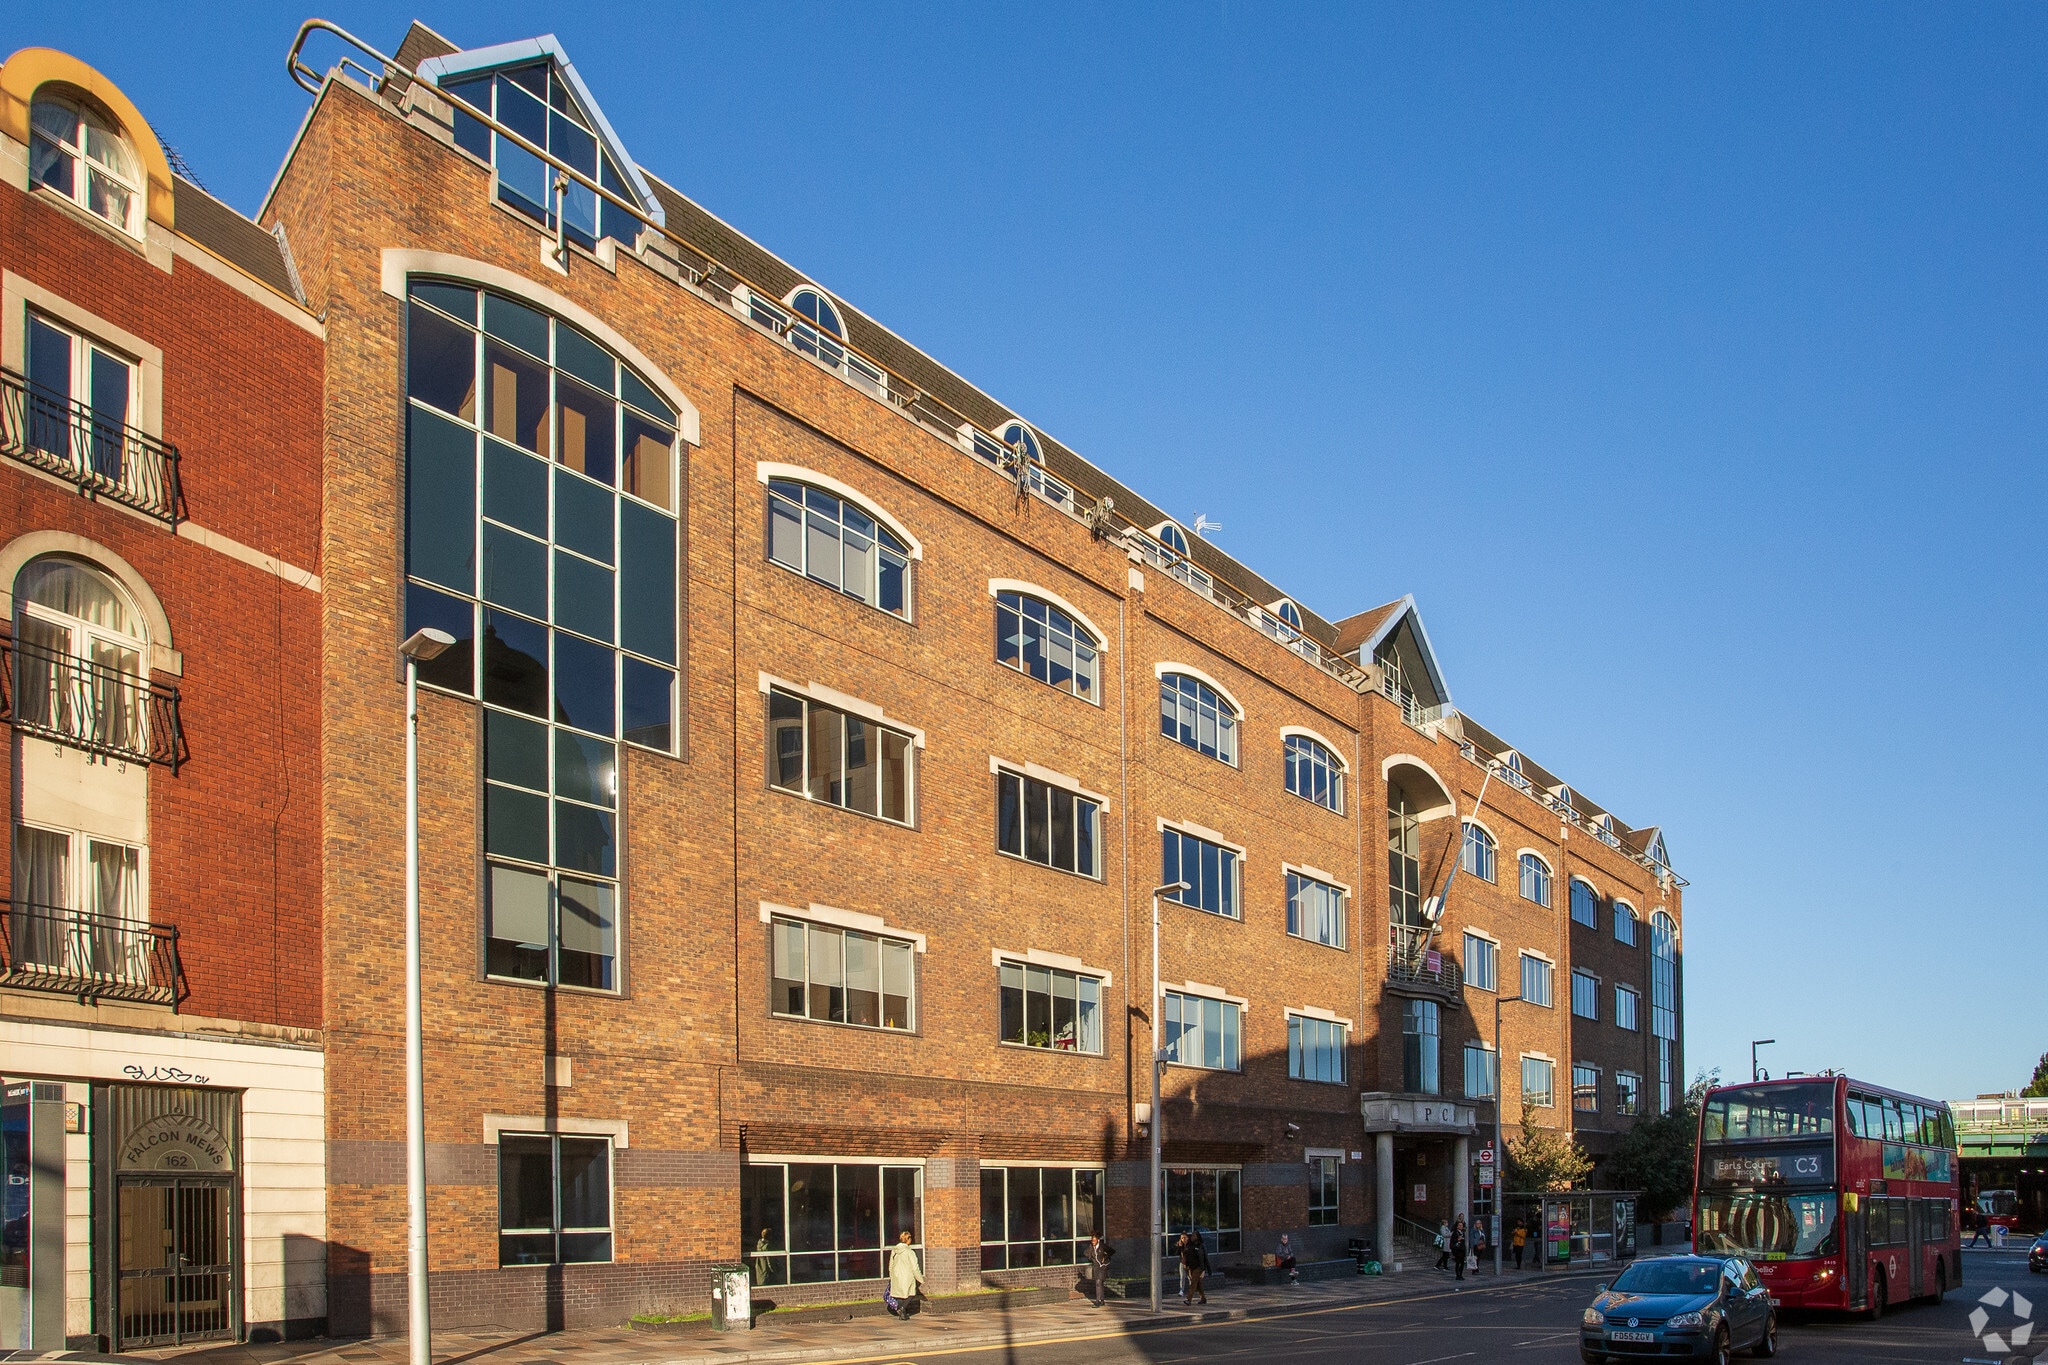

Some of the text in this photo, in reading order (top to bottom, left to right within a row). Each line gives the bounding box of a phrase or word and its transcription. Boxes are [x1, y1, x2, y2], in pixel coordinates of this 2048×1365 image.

[127, 1131, 224, 1165] FALCON MEWS
[164, 1156, 188, 1167] 162
[1718, 1160, 1773, 1170] Earls Court
[1796, 1156, 1819, 1173] C3
